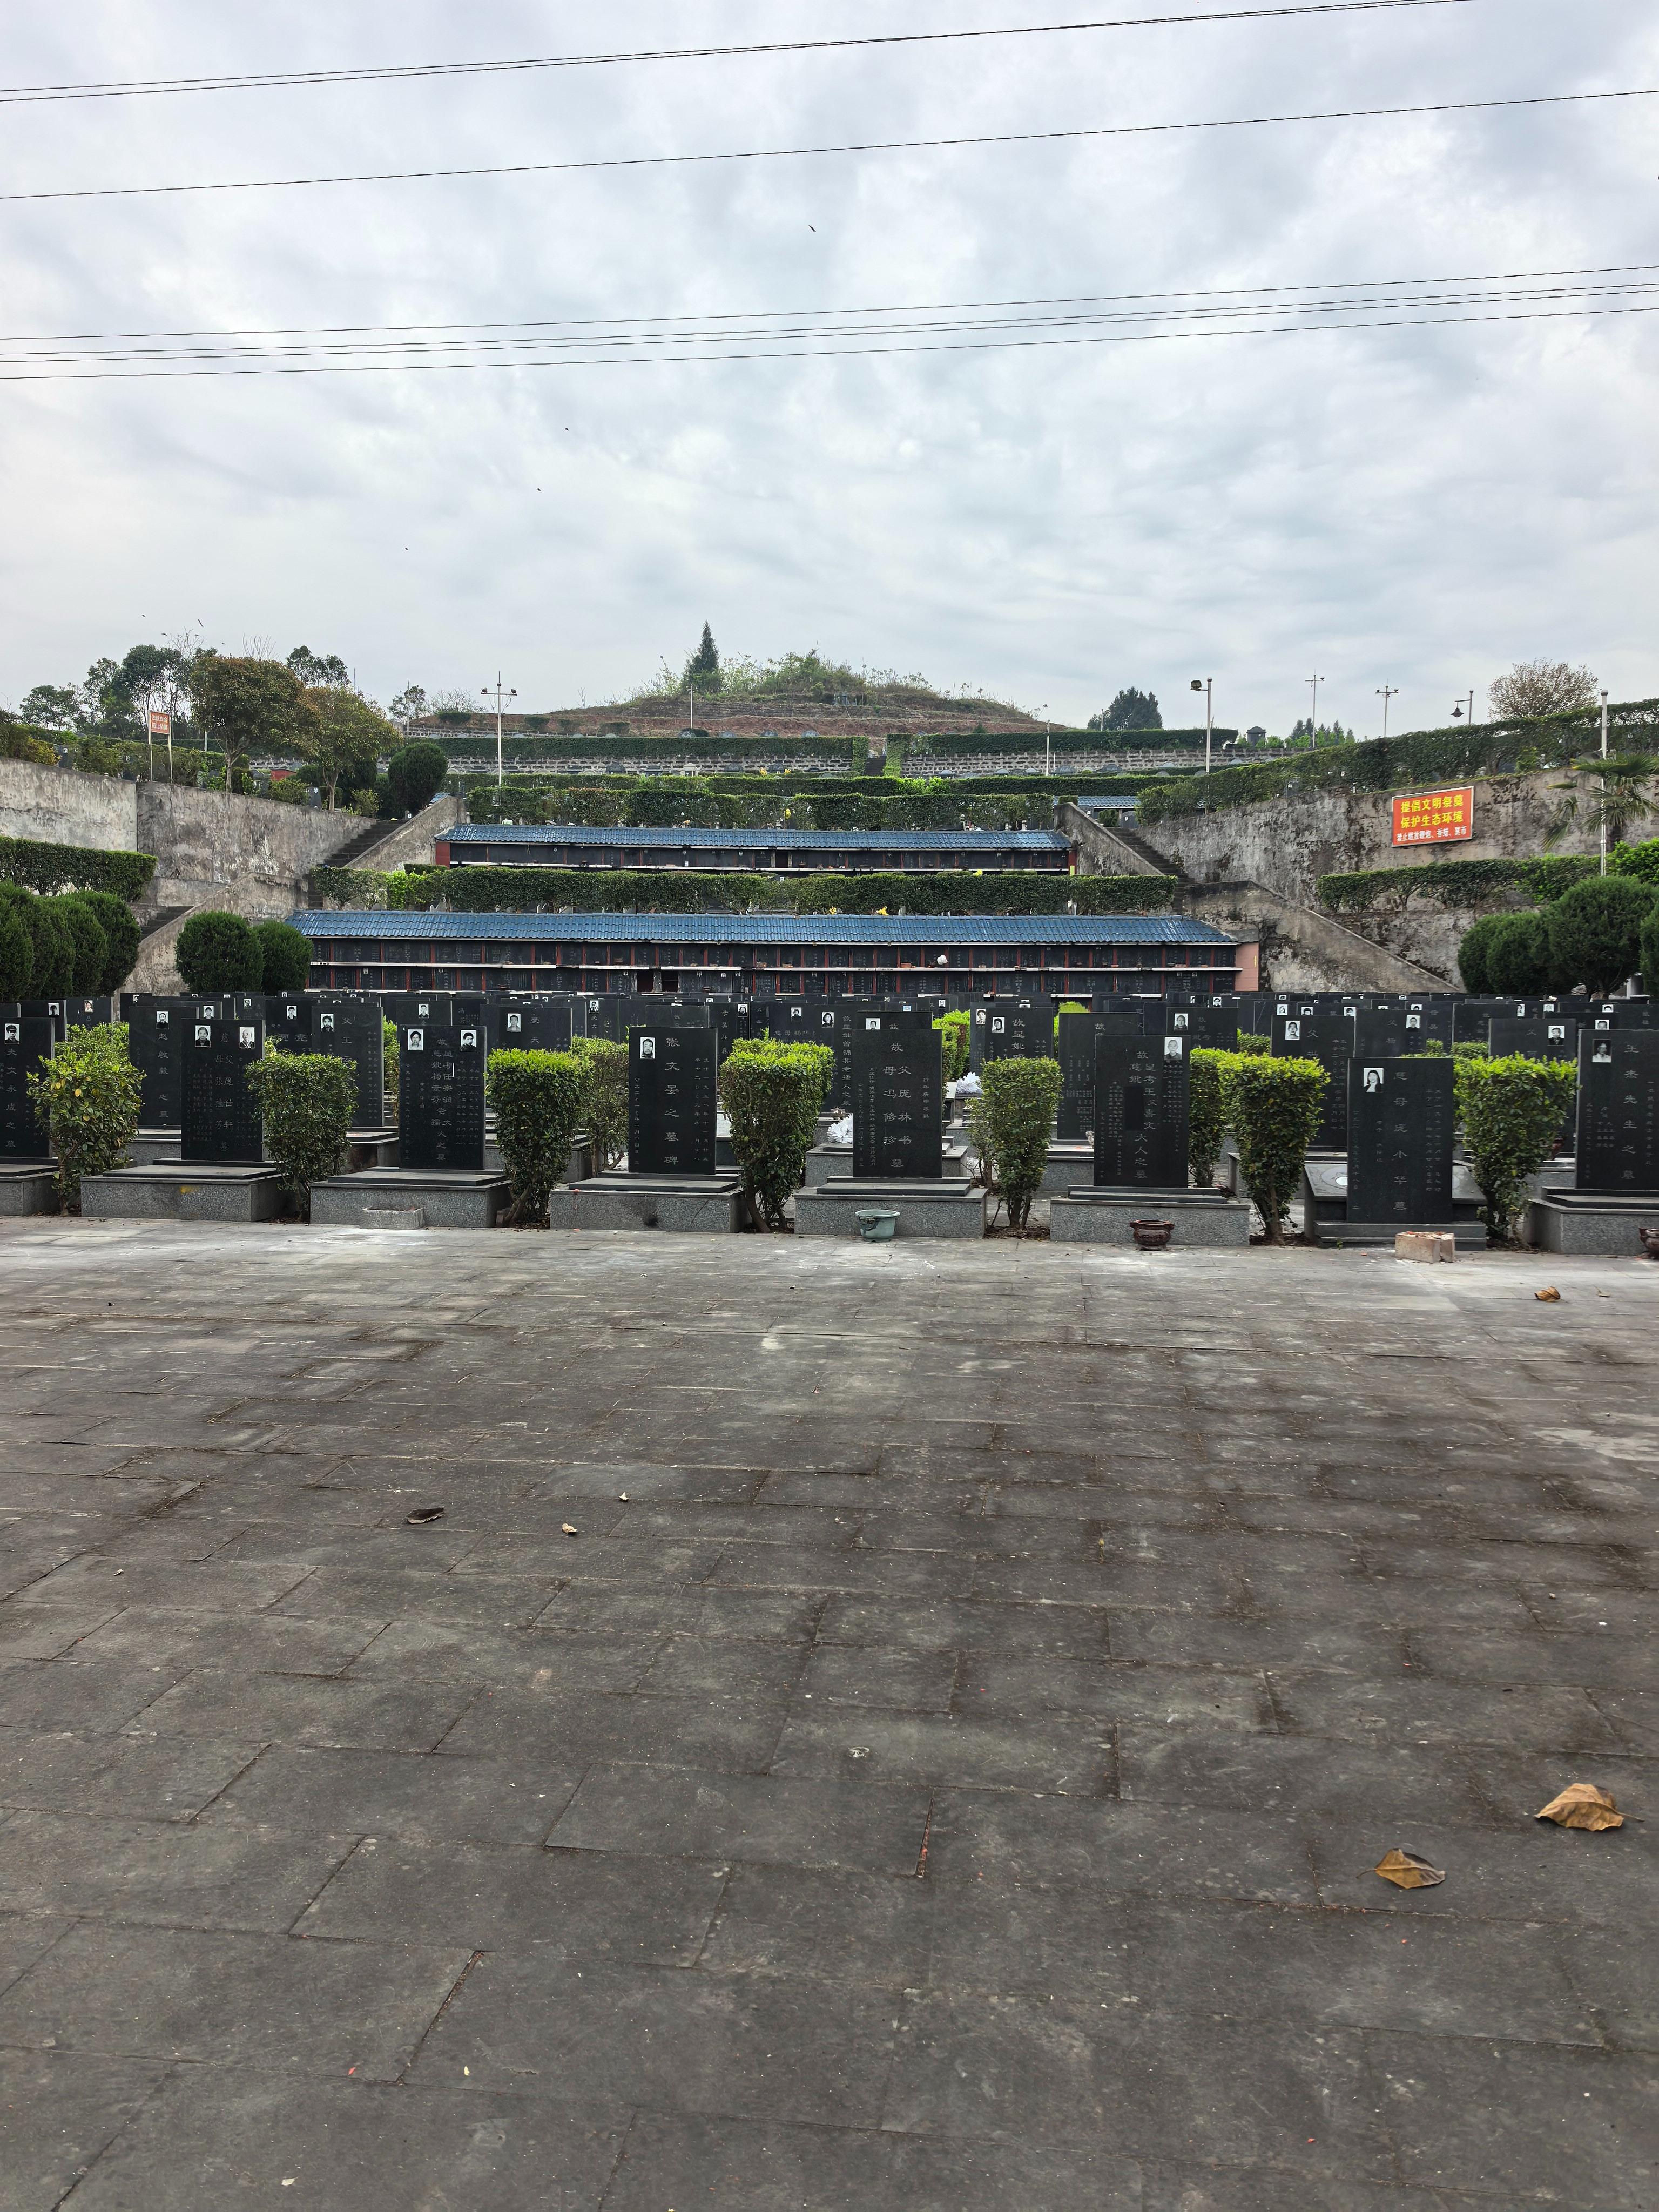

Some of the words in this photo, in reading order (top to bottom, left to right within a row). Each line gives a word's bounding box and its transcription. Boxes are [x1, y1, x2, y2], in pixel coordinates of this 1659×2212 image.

[1401, 794, 1463, 813] 提倡文明祭奠
[1401, 811, 1463, 829] 保护生态环境
[889, 1043, 904, 1052] 故
[664, 1037, 680, 1166] 张文晏之墓碑
[882, 1065, 897, 1145] 母冯修珍
[1621, 1044, 1640, 1180] 王杰先生之墓
